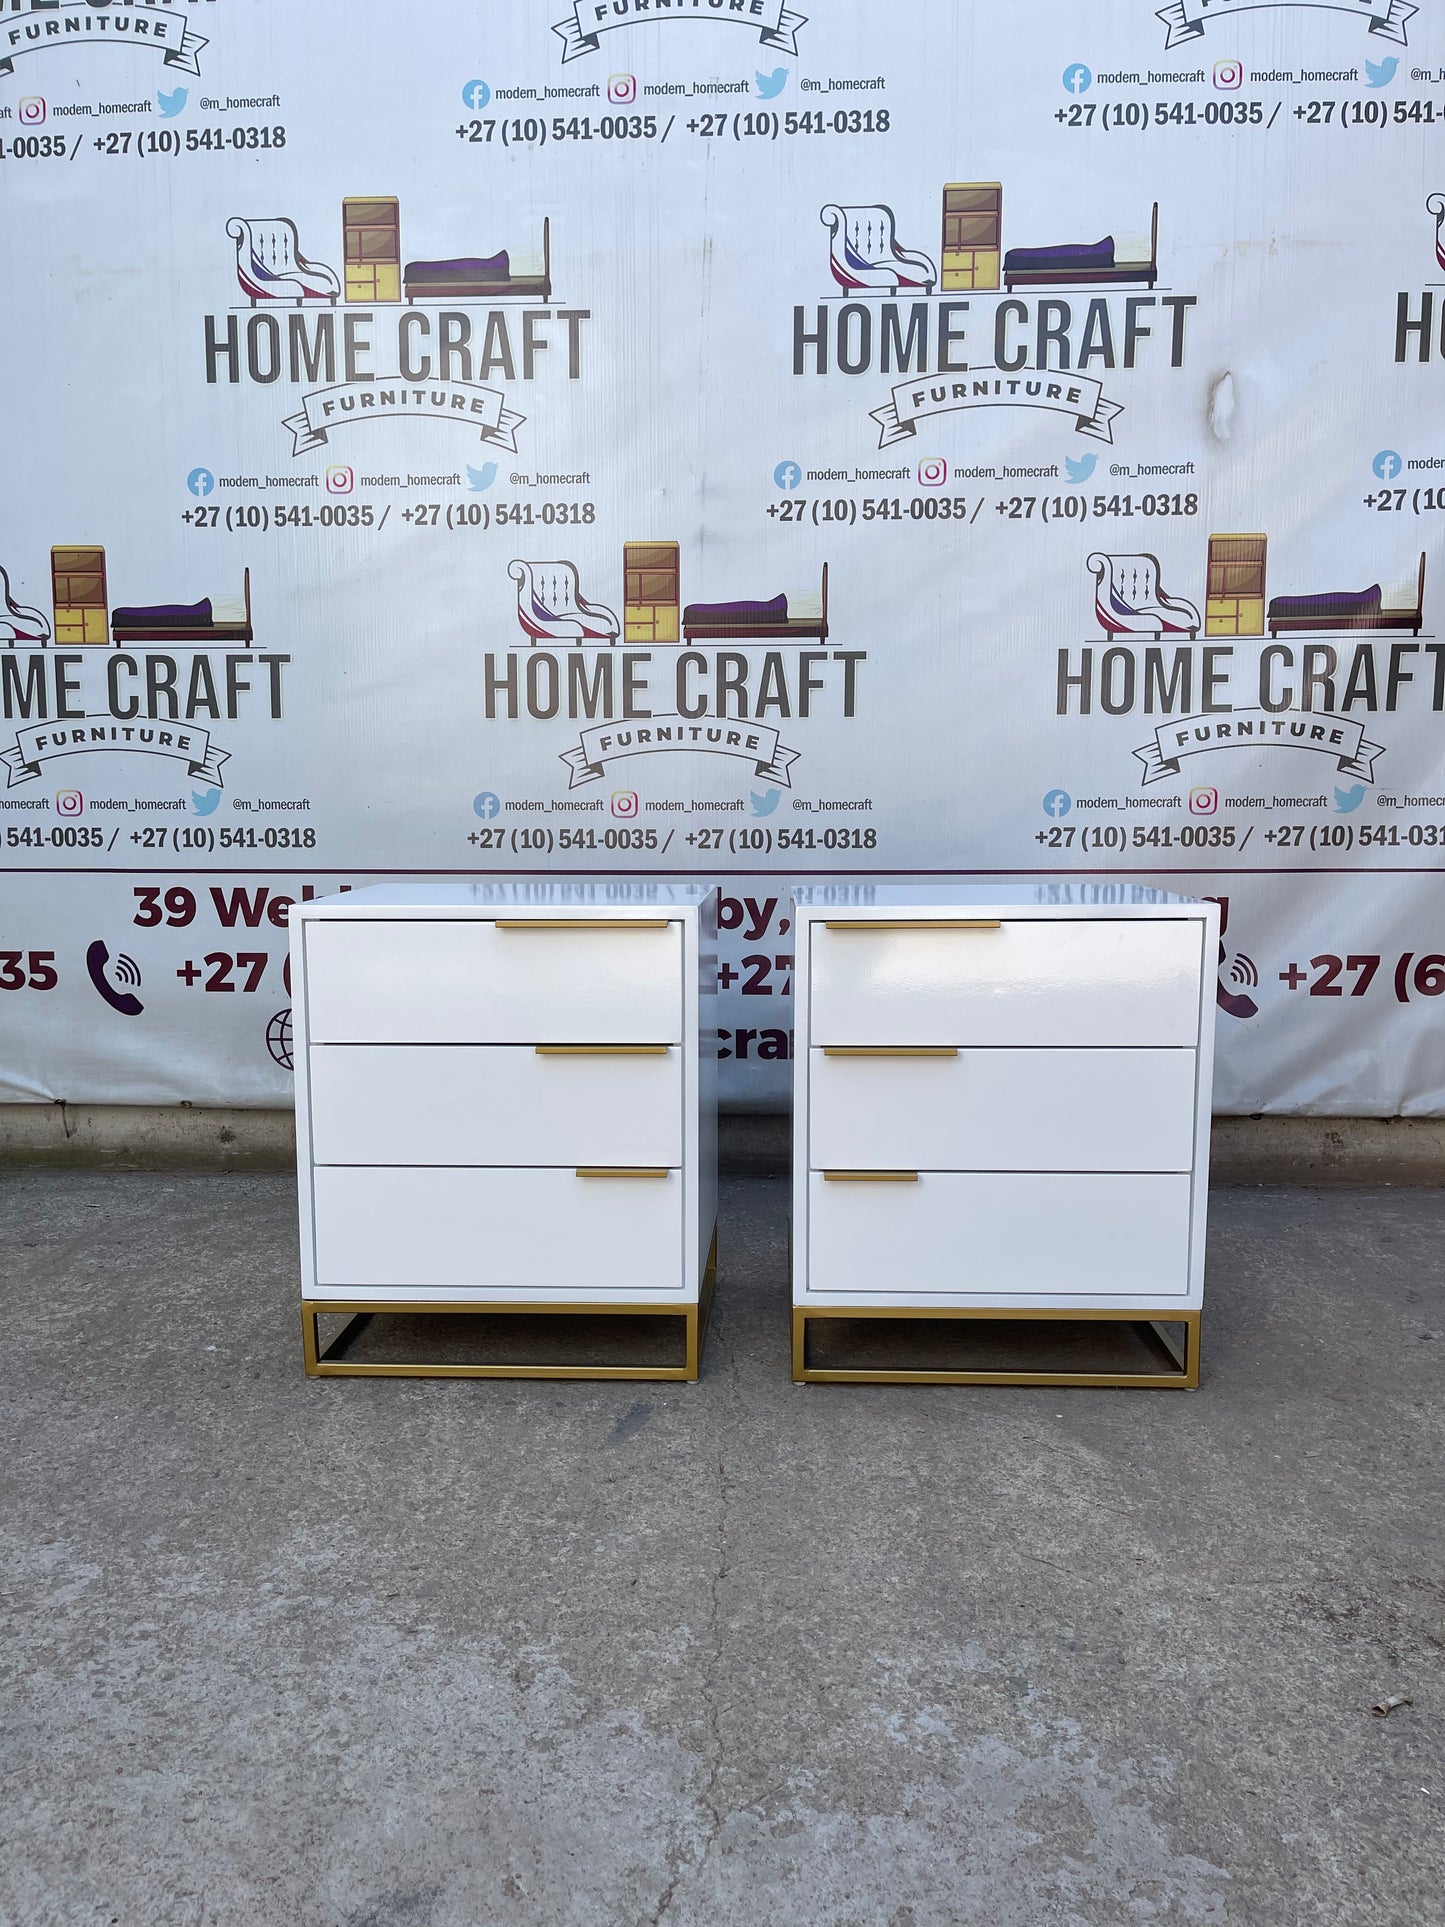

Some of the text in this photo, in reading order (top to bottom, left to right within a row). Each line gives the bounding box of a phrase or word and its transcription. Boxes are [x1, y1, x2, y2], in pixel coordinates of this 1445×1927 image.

[8, 16, 168, 46] FURNITURE
[801, 77, 885, 93] @m_homecraft
[200, 95, 280, 111] @m_homecraft
[1055, 100, 1445, 131] +27 (10) 541-0035 / +27 (10) 541-
[456, 110, 890, 146] +27 (10) 541-0035 / +27 (10) 541-0318
[70, 135, 82, 160] /
[94, 133, 131, 154] +27
[138, 131, 180, 157] (10)
[186, 126, 285, 151] 541-0318
[793, 296, 1197, 377] HOME CRAFT
[1394, 291, 1445, 363] H
[205, 310, 590, 384] HOME CRAFT
[322, 389, 484, 416] FURNITURE
[912, 380, 1082, 408] FURNITURE
[510, 472, 590, 486] @m_homecraft
[1110, 462, 1194, 477] @m_homecraft
[767, 494, 1197, 526] +27 (10) 541-0035 / +27 (10) 541-0318
[1364, 489, 1406, 511] +27
[182, 503, 595, 531] +27 (10) 541-0035 / +27 (10) 541-0318
[105, 654, 290, 721] CRAFT
[485, 651, 866, 721] HOME CRAFT
[1057, 644, 1445, 717] HOME CRAFT
[35, 727, 191, 750] FURNITURE
[601, 727, 760, 751] FURNITURE
[1176, 721, 1344, 746] FURNITURE
[233, 799, 310, 812] @m_homecraft
[793, 799, 872, 812] @m_homecraft
[7, 827, 316, 852] 541-0035 / +27 (10) 541-0318
[468, 828, 876, 853] +27 (10) 541-0035 / +27 (10) 541-0318
[1035, 827, 1075, 847] +27
[1082, 827, 1126, 852] (10)
[1133, 826, 1235, 847] 541-0035
[1239, 826, 1254, 851] /
[1265, 826, 1304, 846] +27
[1310, 826, 1353, 851] (10)
[133, 887, 196, 927] 39
[177, 952, 268, 992] +27
[1279, 955, 1380, 996] +27
